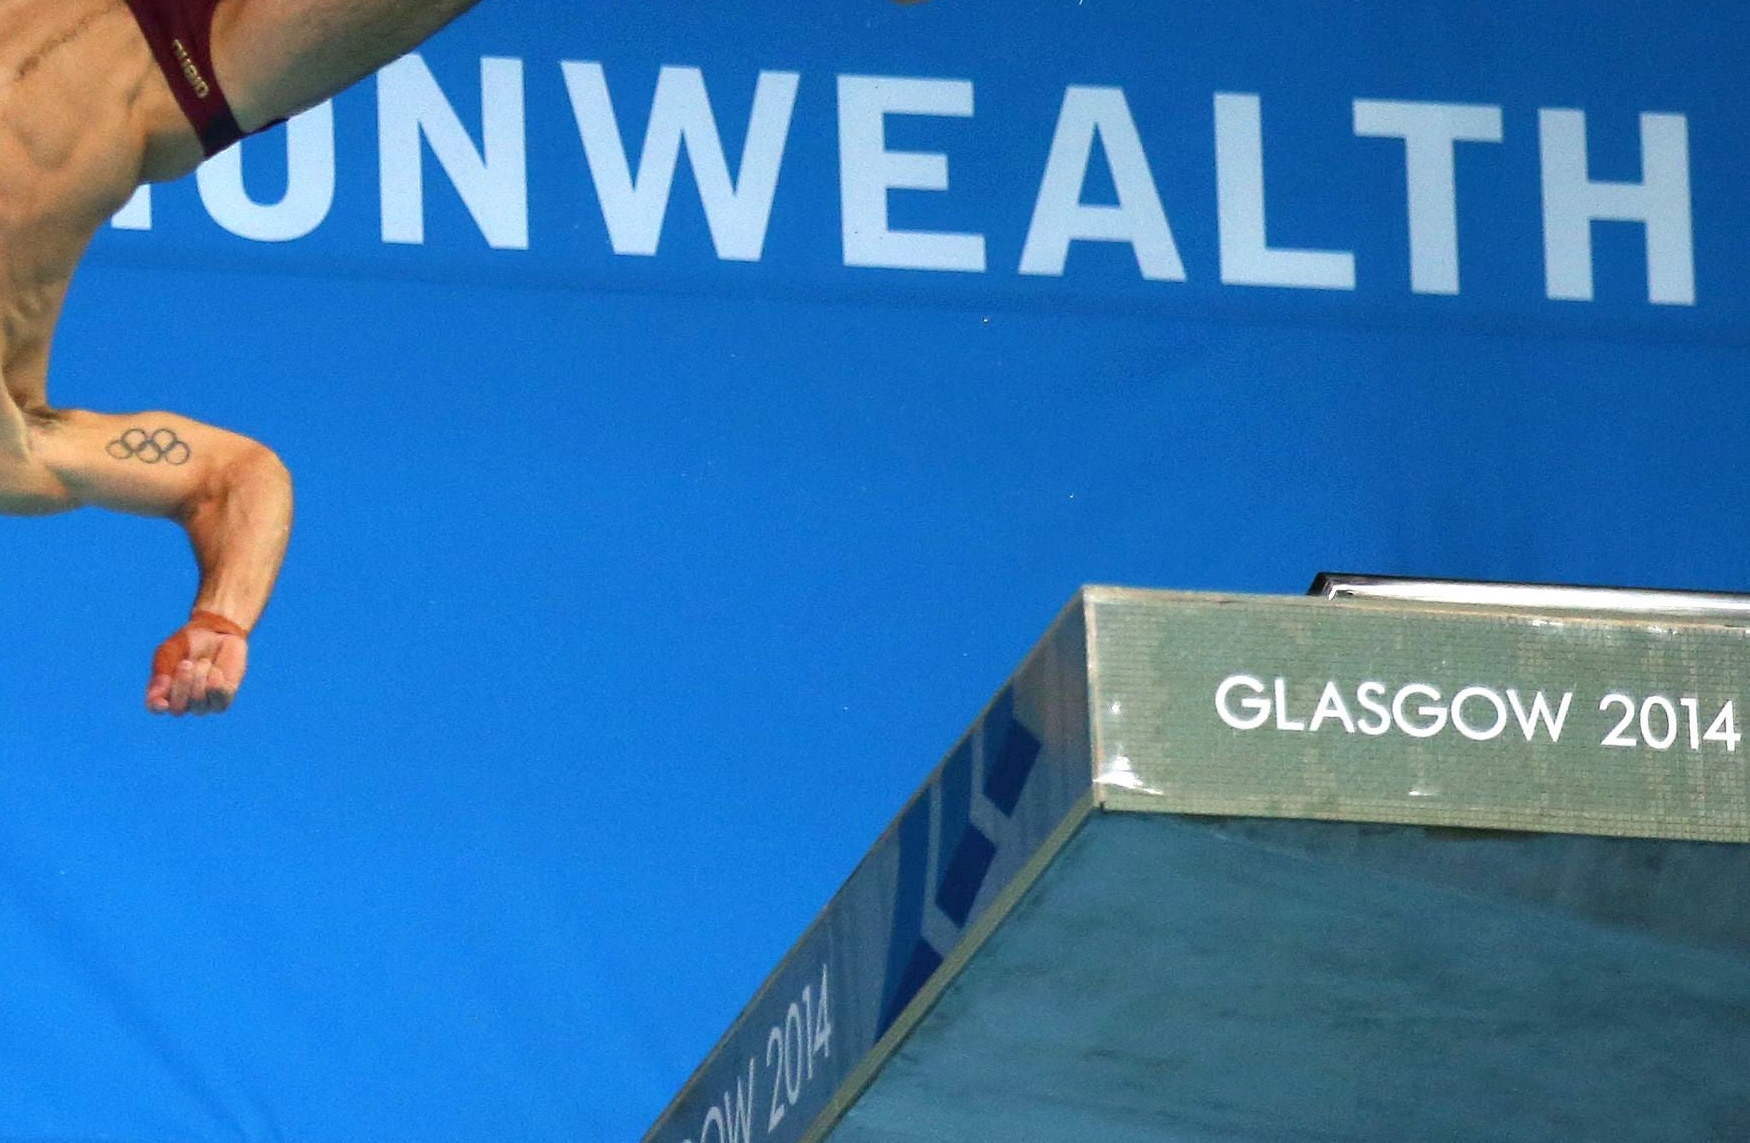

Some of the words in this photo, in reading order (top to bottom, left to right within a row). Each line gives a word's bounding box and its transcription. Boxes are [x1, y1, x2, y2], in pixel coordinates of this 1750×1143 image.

[1213, 674, 1574, 743] GLASGOW
[1597, 691, 1743, 754] 2014
[765, 963, 832, 1135] 2014
